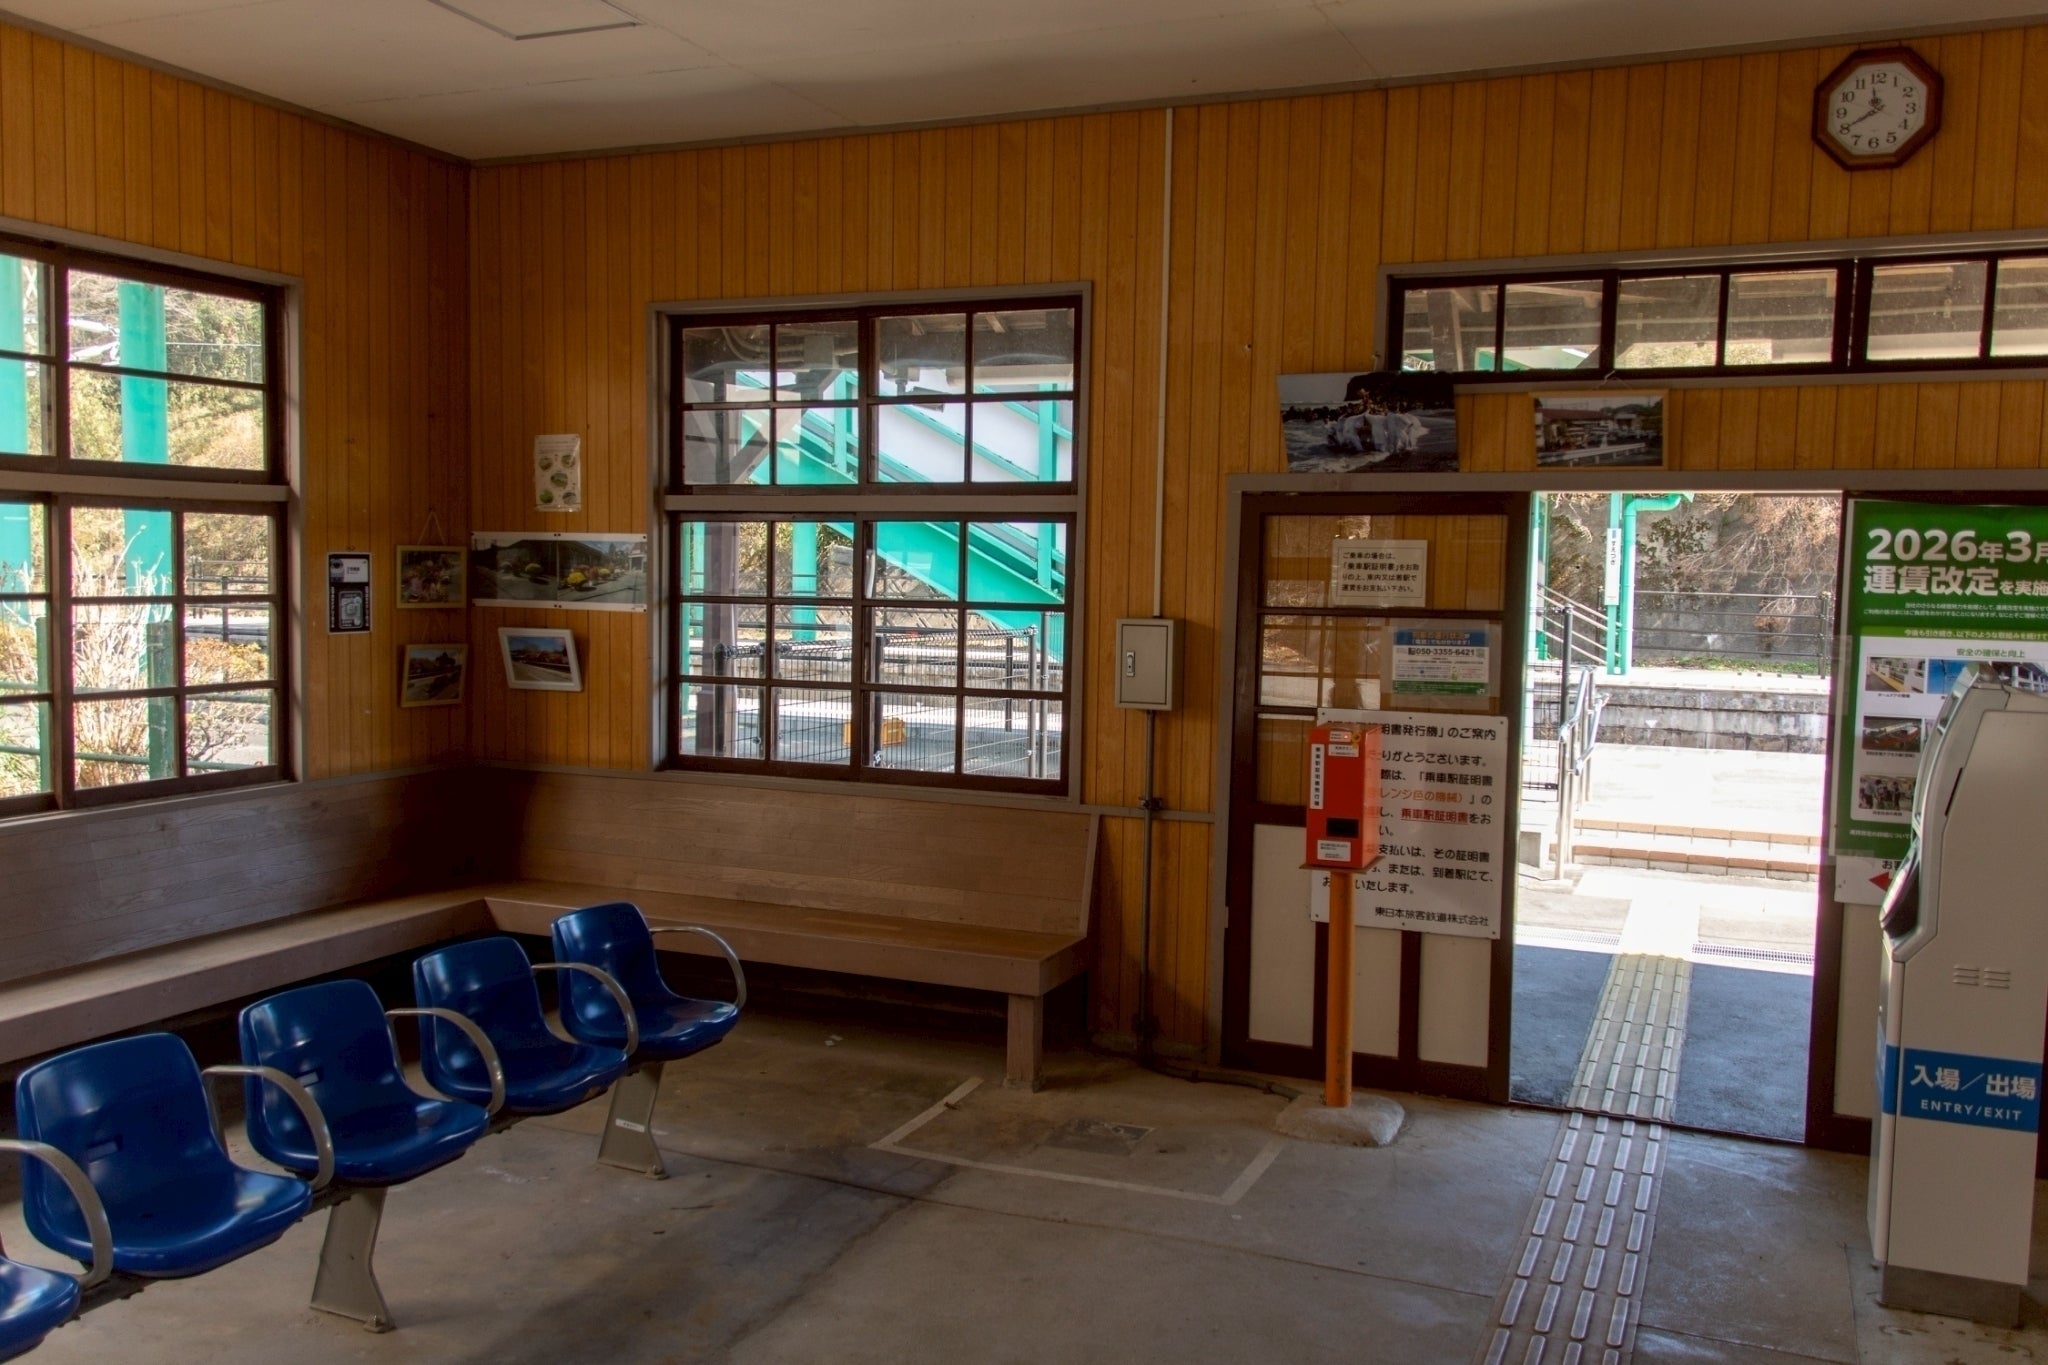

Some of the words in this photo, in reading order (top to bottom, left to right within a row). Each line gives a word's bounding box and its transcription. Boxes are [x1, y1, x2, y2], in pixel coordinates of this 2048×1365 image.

[1871, 72, 1887, 84] 12
[1893, 75, 1899, 87] 1
[1855, 79, 1865, 90] 11
[1841, 91, 1855, 103] 10
[1902, 87, 1913, 97] 2
[1836, 107, 1847, 119] 9
[1905, 102, 1916, 114] 3
[1839, 123, 1850, 135] 8
[1899, 119, 1908, 130] 4
[1851, 135, 1862, 146] 7
[1868, 137, 1879, 149] 6
[1886, 132, 1897, 144] 5
[1920, 1099, 2022, 1121] ENTRY/EXIT
